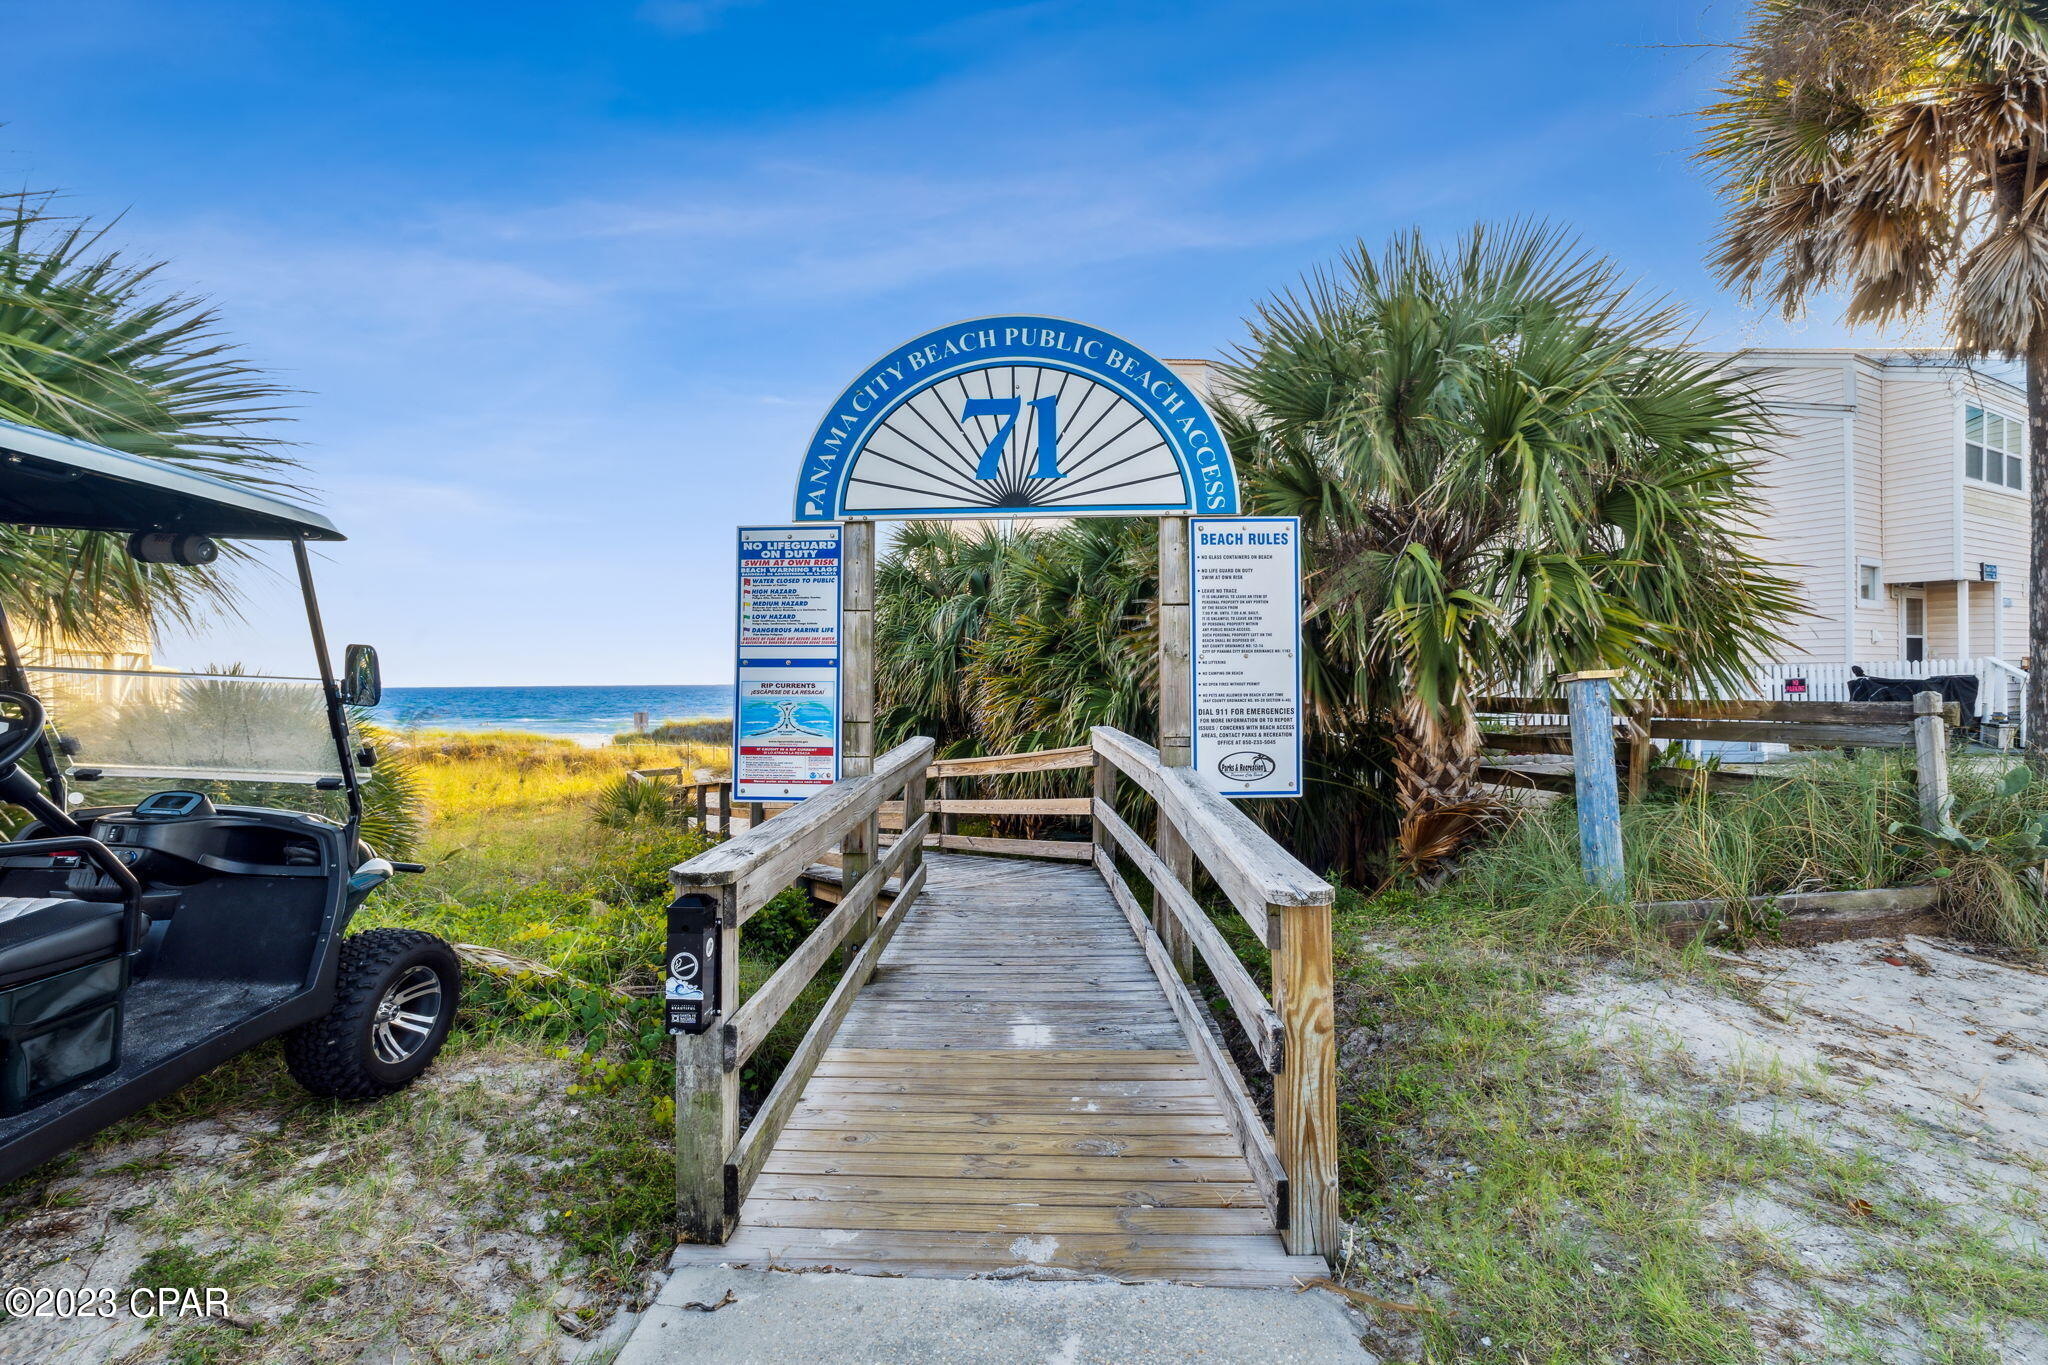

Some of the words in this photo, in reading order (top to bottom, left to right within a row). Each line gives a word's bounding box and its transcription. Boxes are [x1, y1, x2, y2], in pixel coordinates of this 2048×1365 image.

[805, 414, 859, 516] PANAMA
[852, 362, 903, 412] CITY
[907, 329, 997, 371] BEACH
[1006, 328, 1102, 359] PUBLIC
[1105, 349, 1184, 415] BEACH
[1176, 412, 1225, 510] ACCESS
[961, 394, 1067, 480] 71
[1201, 533, 1242, 545] BEACH
[1248, 533, 1288, 545] RULES
